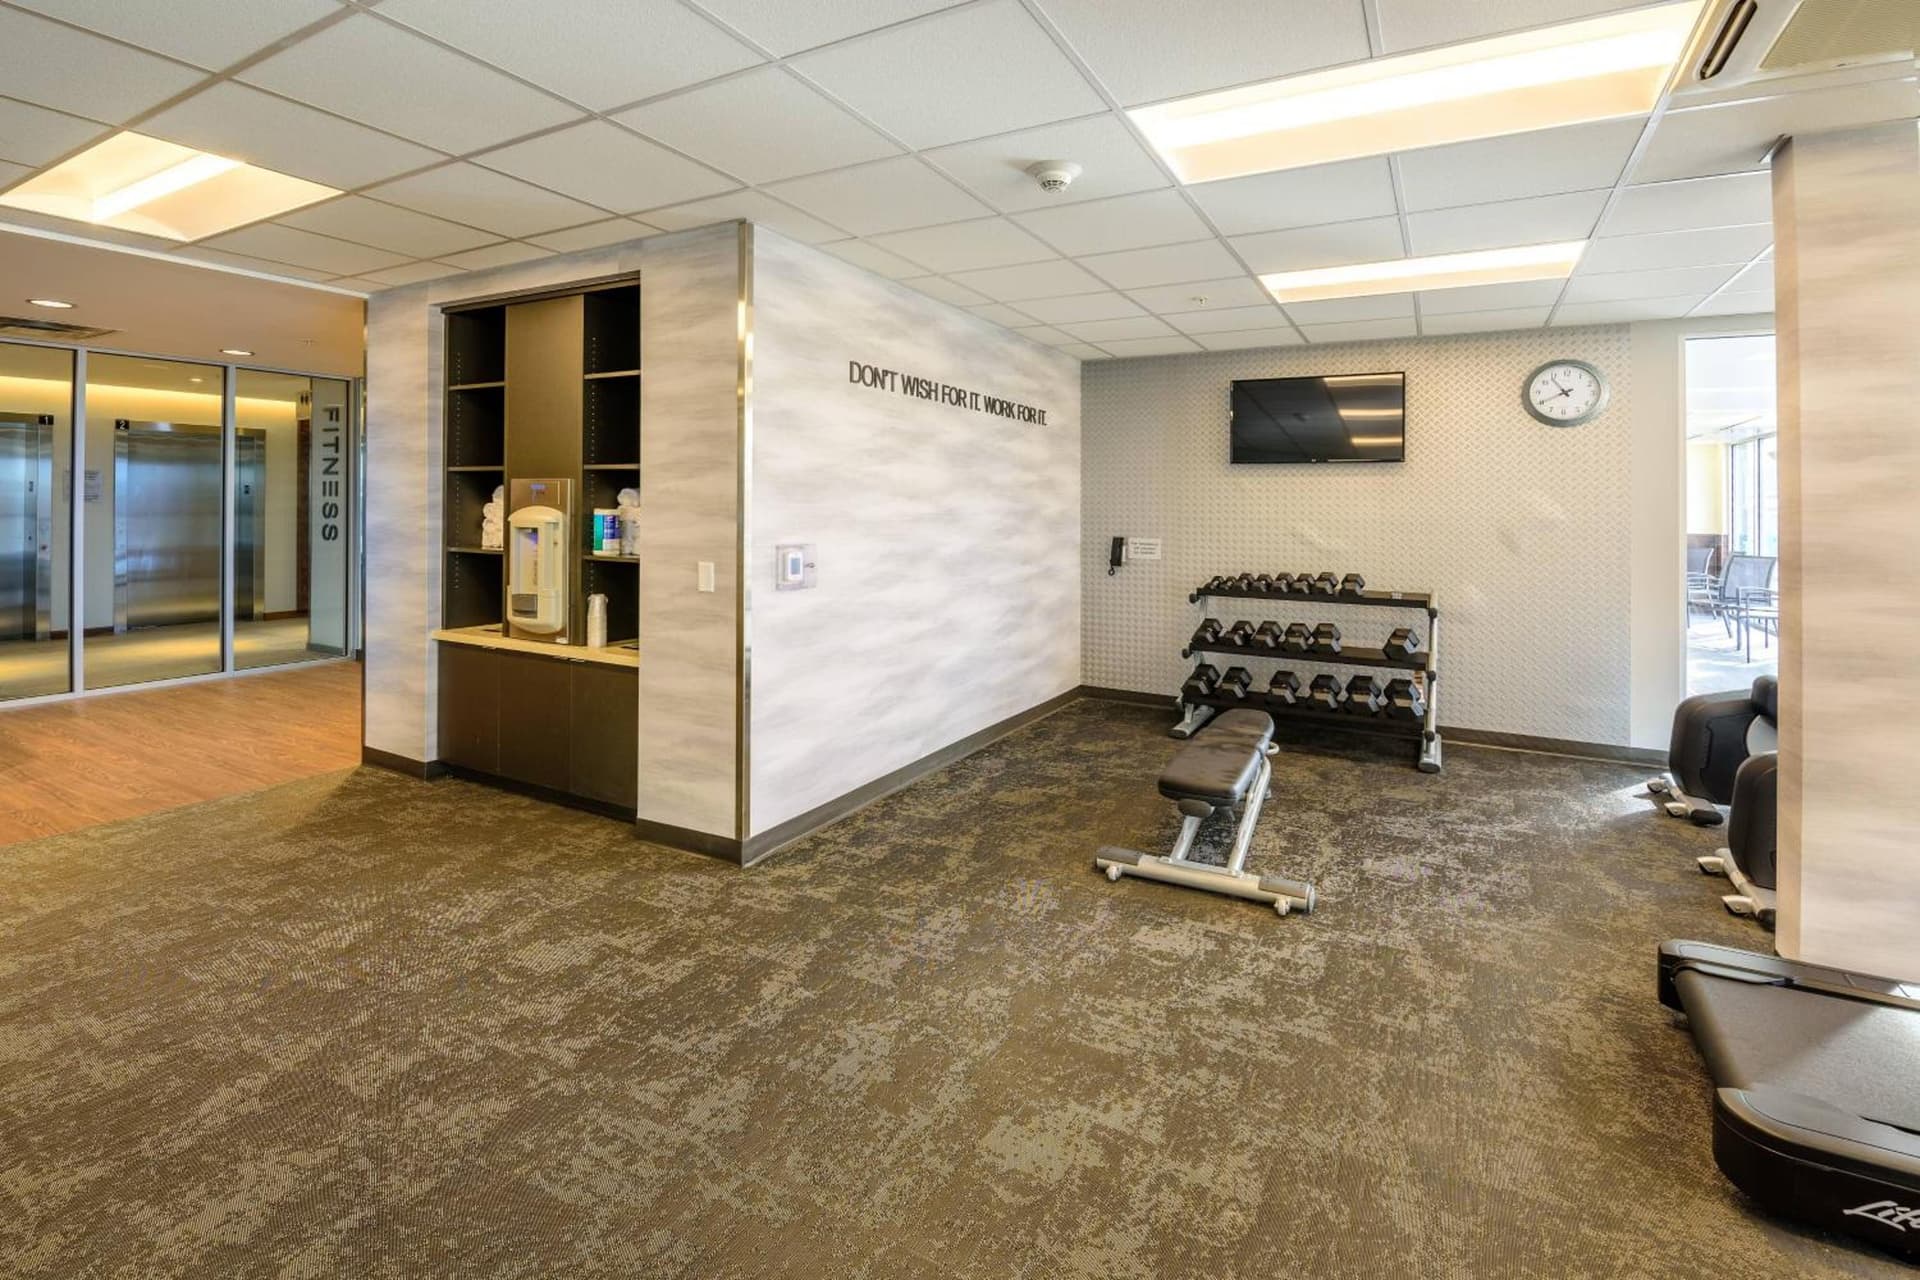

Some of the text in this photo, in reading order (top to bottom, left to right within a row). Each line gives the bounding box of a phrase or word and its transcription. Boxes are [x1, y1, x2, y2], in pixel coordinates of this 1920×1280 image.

[849, 361, 898, 392] DON'T
[901, 374, 938, 401] WISH
[942, 384, 967, 408] FOR
[984, 395, 1016, 419] WORK
[1017, 404, 1036, 424] FOR
[119, 420, 126, 430] 2
[322, 407, 339, 541] FITNESS
